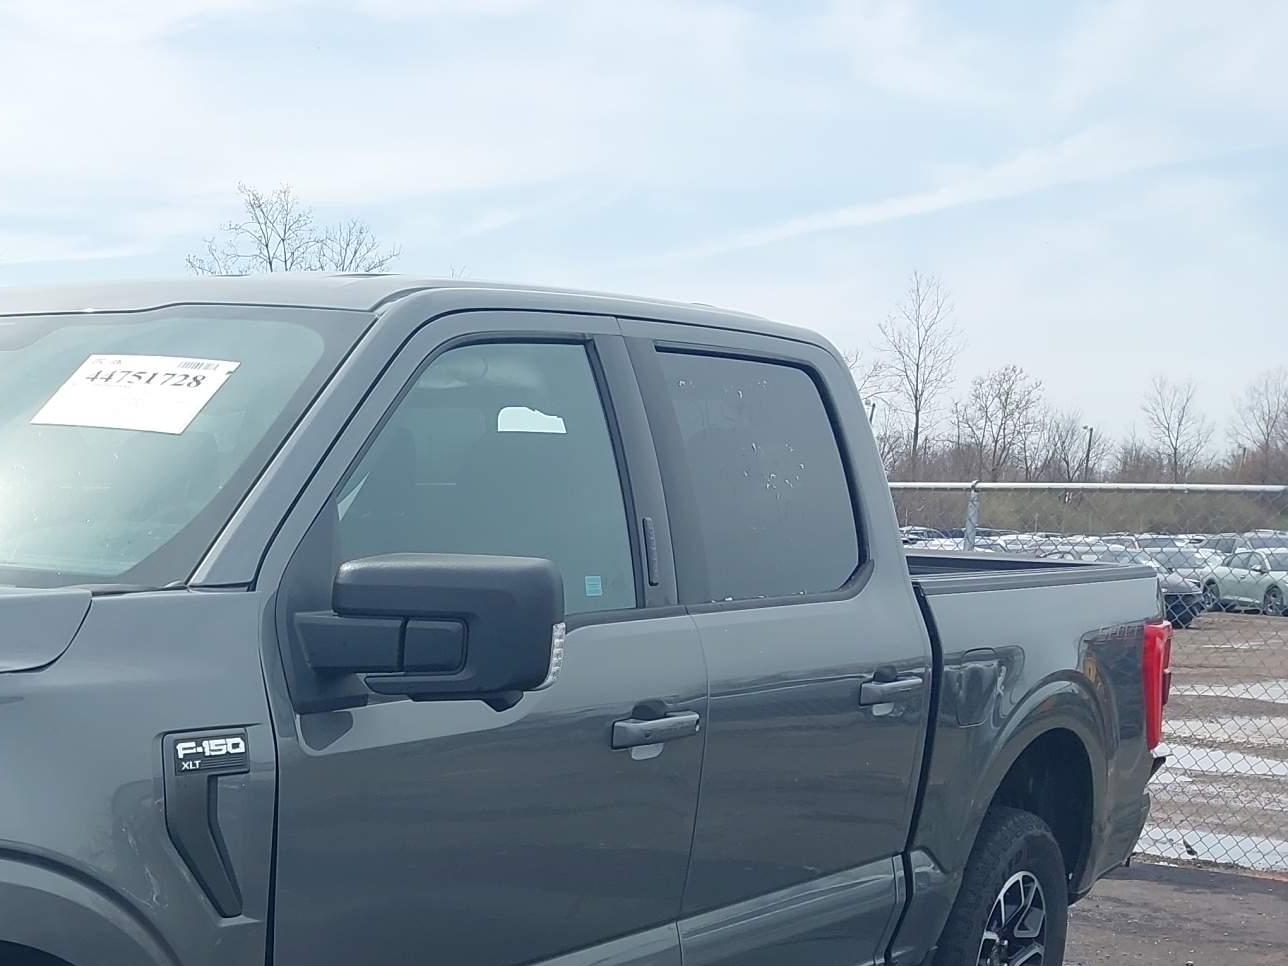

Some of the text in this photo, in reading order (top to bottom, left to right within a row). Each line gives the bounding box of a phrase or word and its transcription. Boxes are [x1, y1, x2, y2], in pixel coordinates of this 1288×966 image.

[85, 369, 206, 388] 44751728
[176, 737, 246, 759] F-150
[181, 760, 201, 770] XLT
